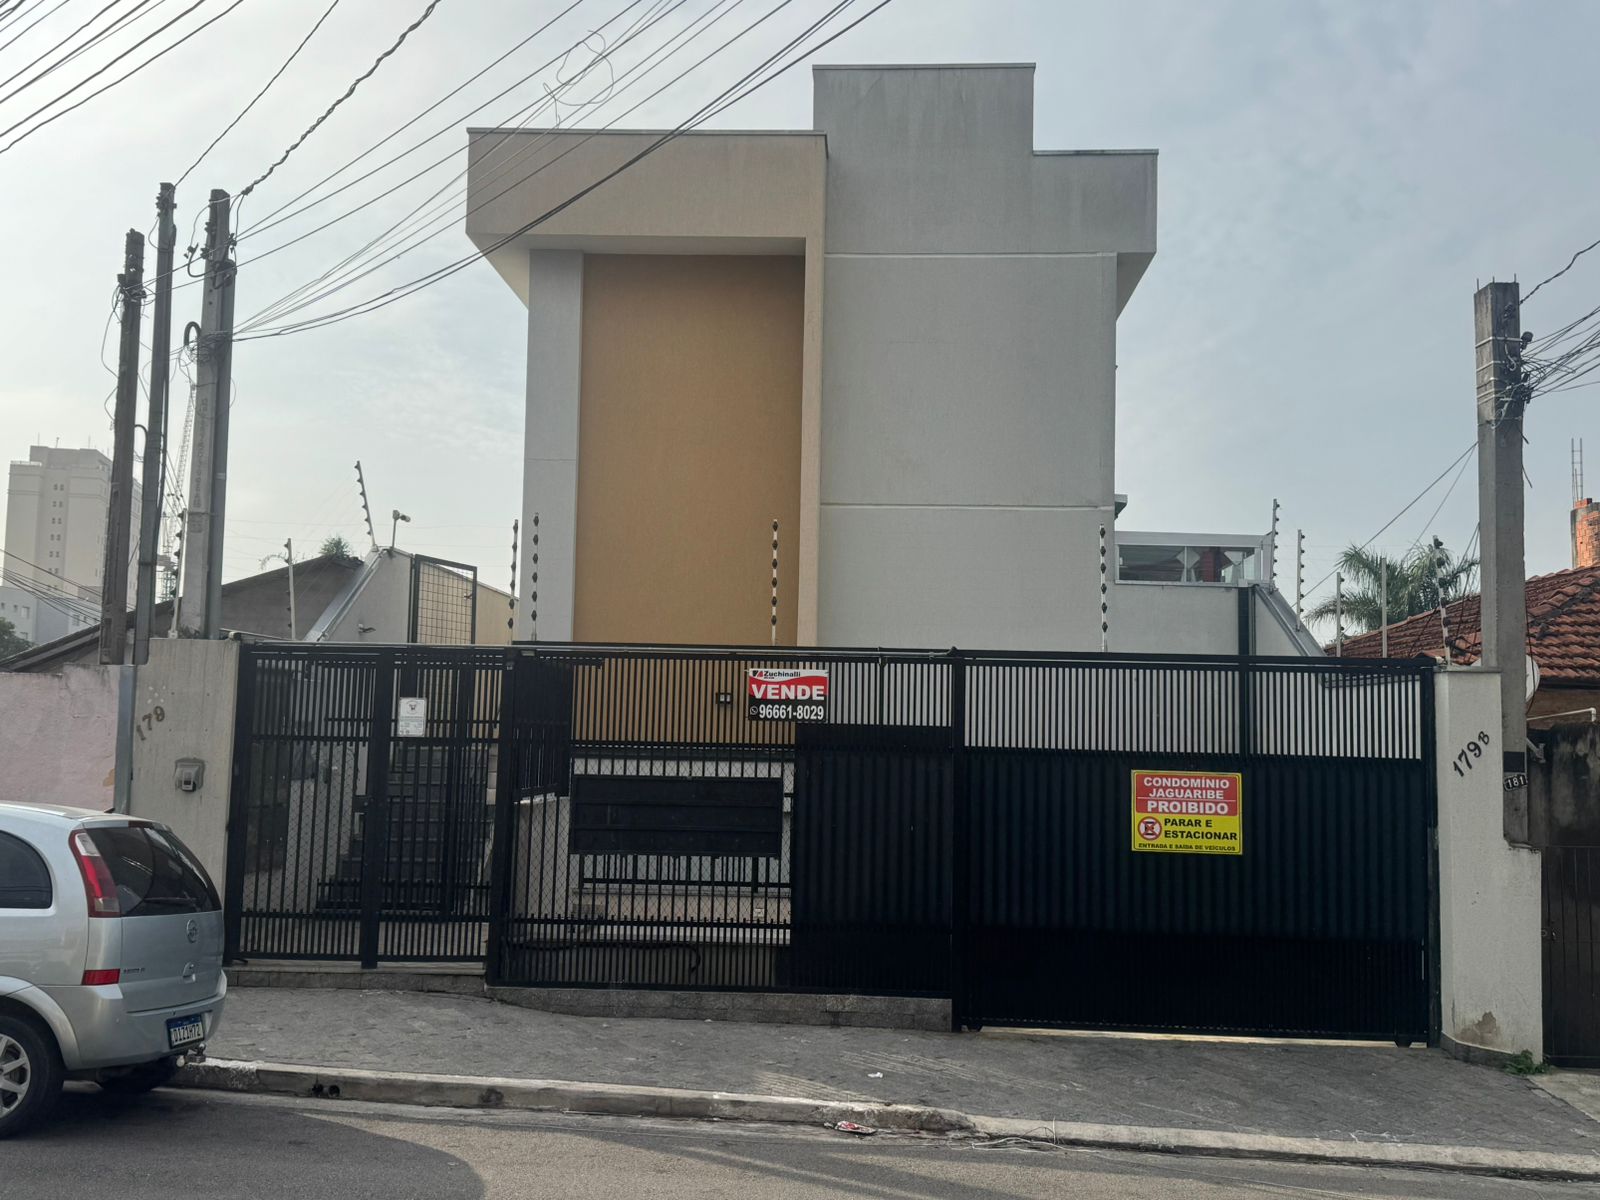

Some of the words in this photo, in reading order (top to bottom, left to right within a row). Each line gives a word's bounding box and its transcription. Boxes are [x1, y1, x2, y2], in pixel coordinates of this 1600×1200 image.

[751, 684, 825, 700] VENDE
[759, 704, 824, 720] 96661-8029
[1143, 776, 1230, 789] CONDOMÍNIO
[1507, 776, 1524, 787] 181
[1149, 788, 1224, 800] JAGUARIBE
[1147, 800, 1229, 815] PROIBIDO
[1164, 818, 1202, 828] PARAR
[1205, 819, 1213, 828] E
[1164, 830, 1238, 841] ESTACIONAR
[1138, 842, 1168, 850] ENTRADA
